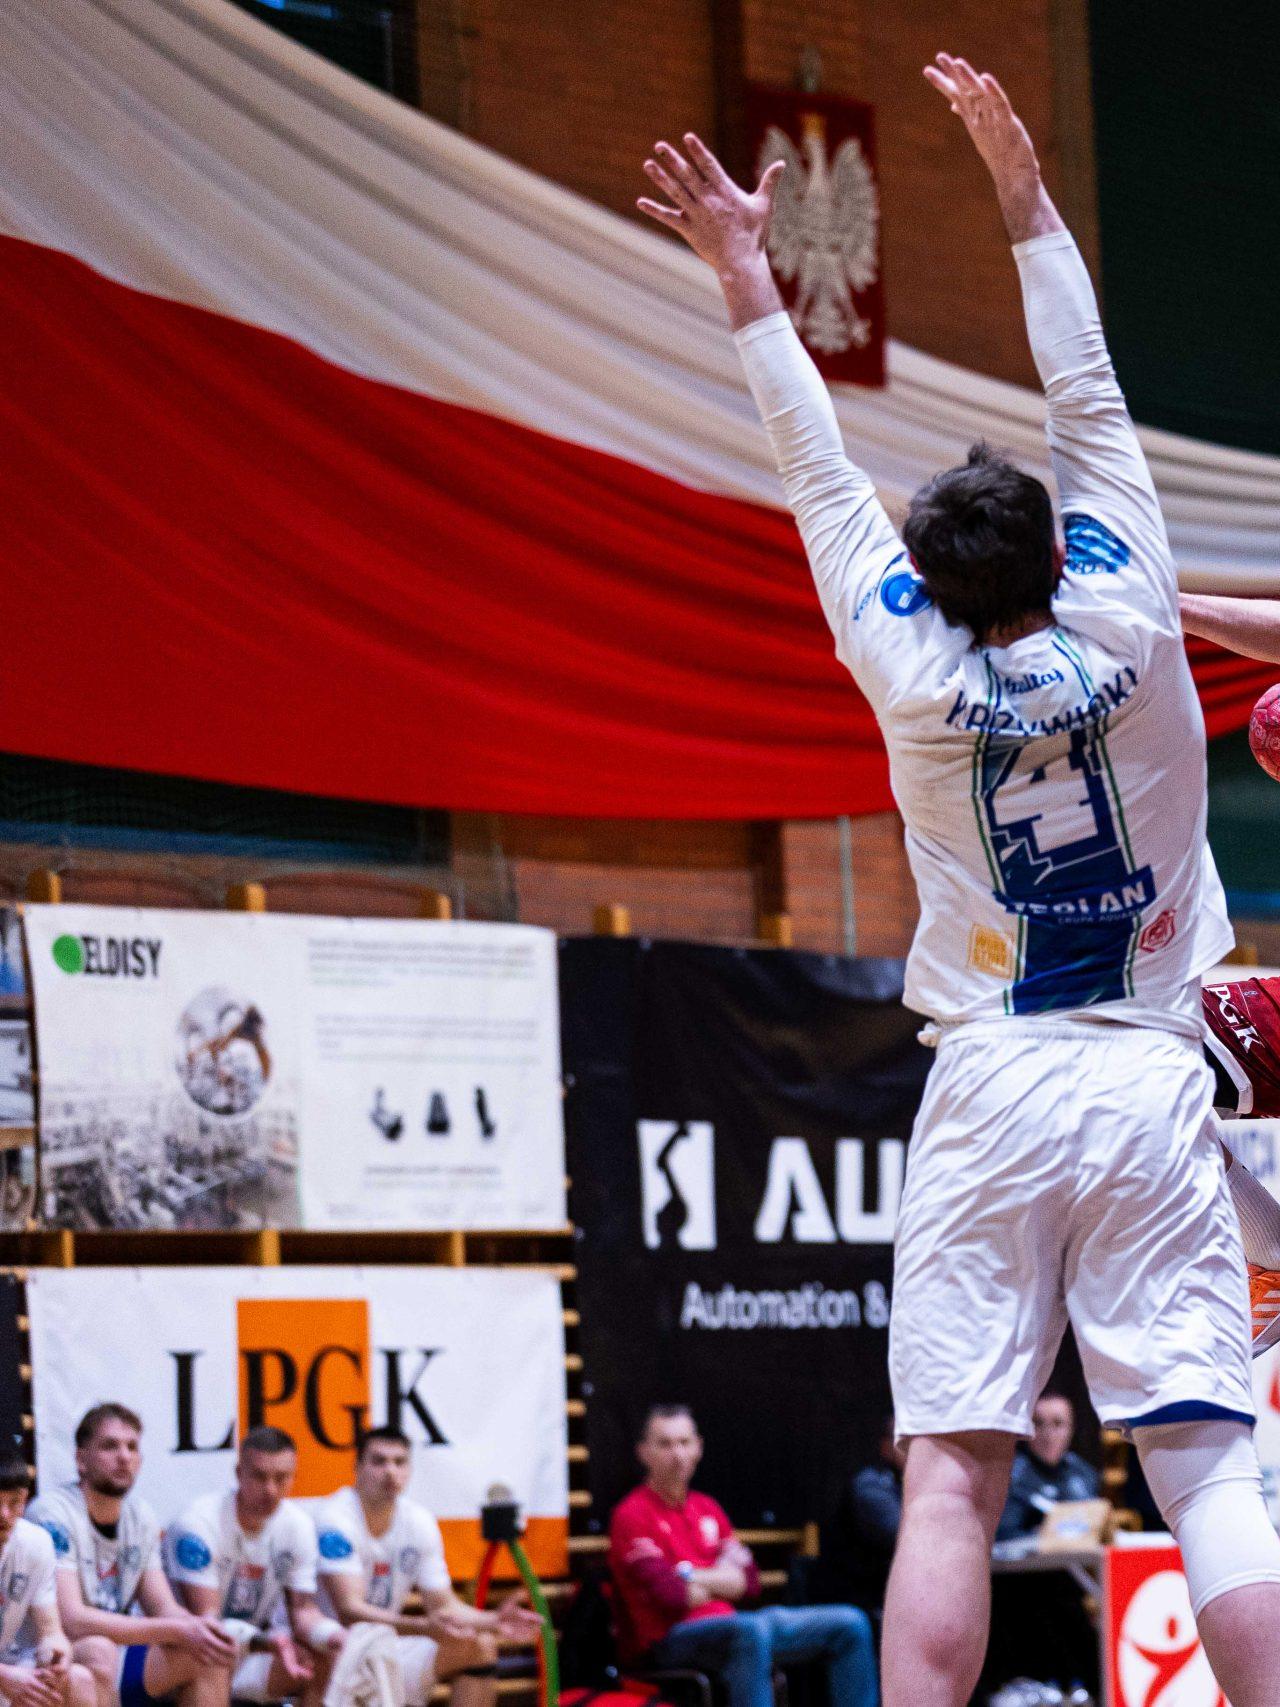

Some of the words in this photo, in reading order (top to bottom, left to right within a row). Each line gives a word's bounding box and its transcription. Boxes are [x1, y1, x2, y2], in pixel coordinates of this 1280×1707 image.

[82, 935, 162, 978] ELDISY
[680, 1280, 862, 1330] Automation
[863, 1280, 890, 1329] &
